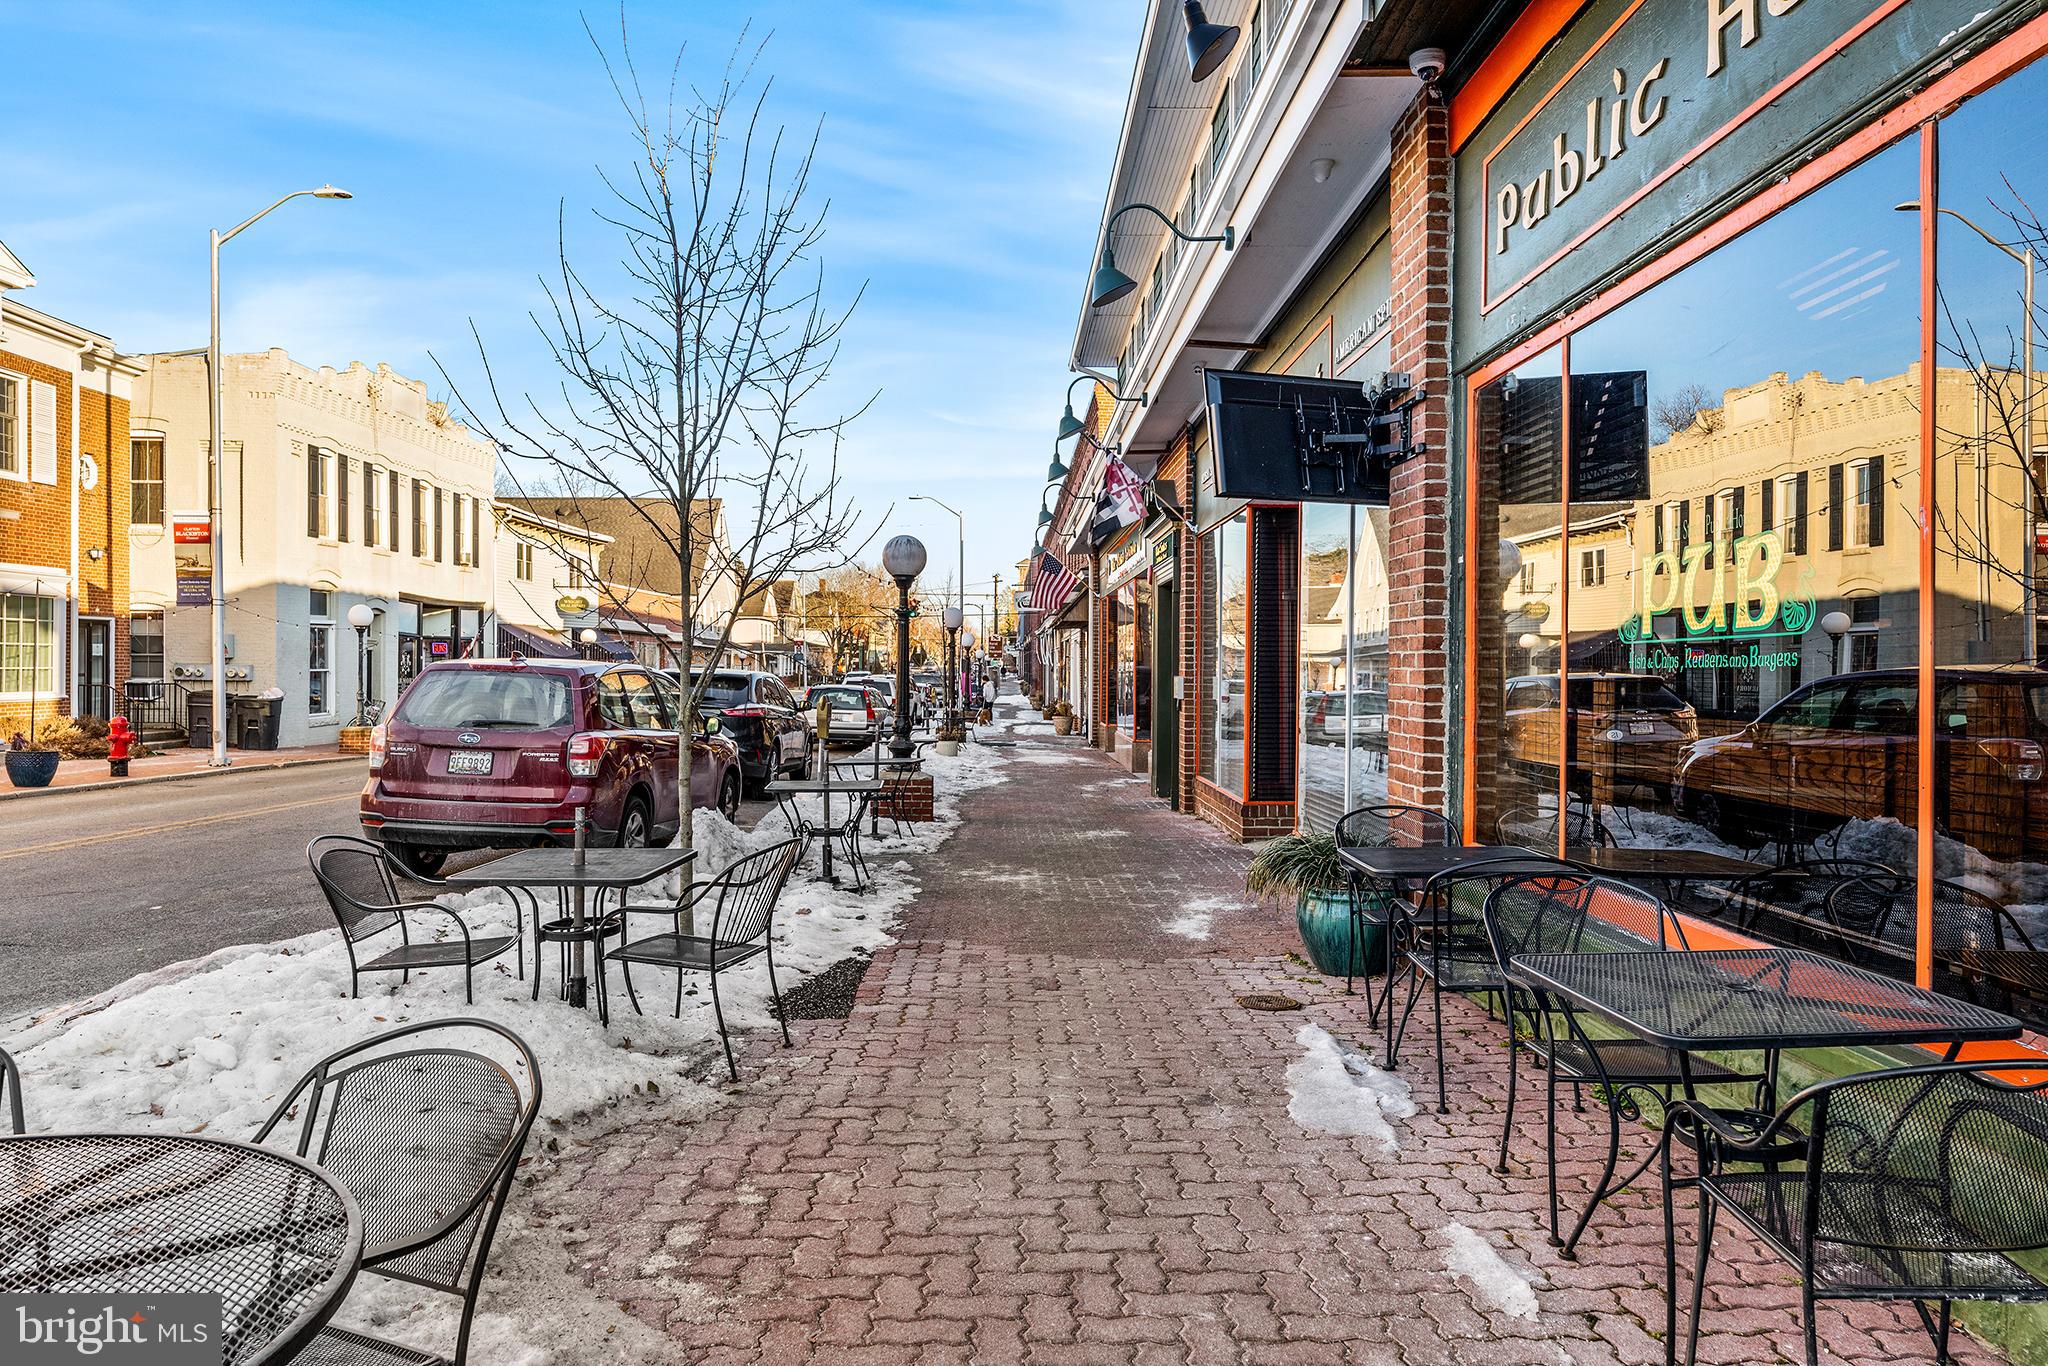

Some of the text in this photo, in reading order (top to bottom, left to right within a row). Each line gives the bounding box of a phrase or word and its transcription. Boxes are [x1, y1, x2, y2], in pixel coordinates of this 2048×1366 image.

[1497, 58, 1667, 255] Public
[1336, 314, 1375, 364] AMERICAN
[1641, 529, 1784, 639] PUB
[1729, 654, 1748, 668] and
[1749, 644, 1798, 672] Burgers
